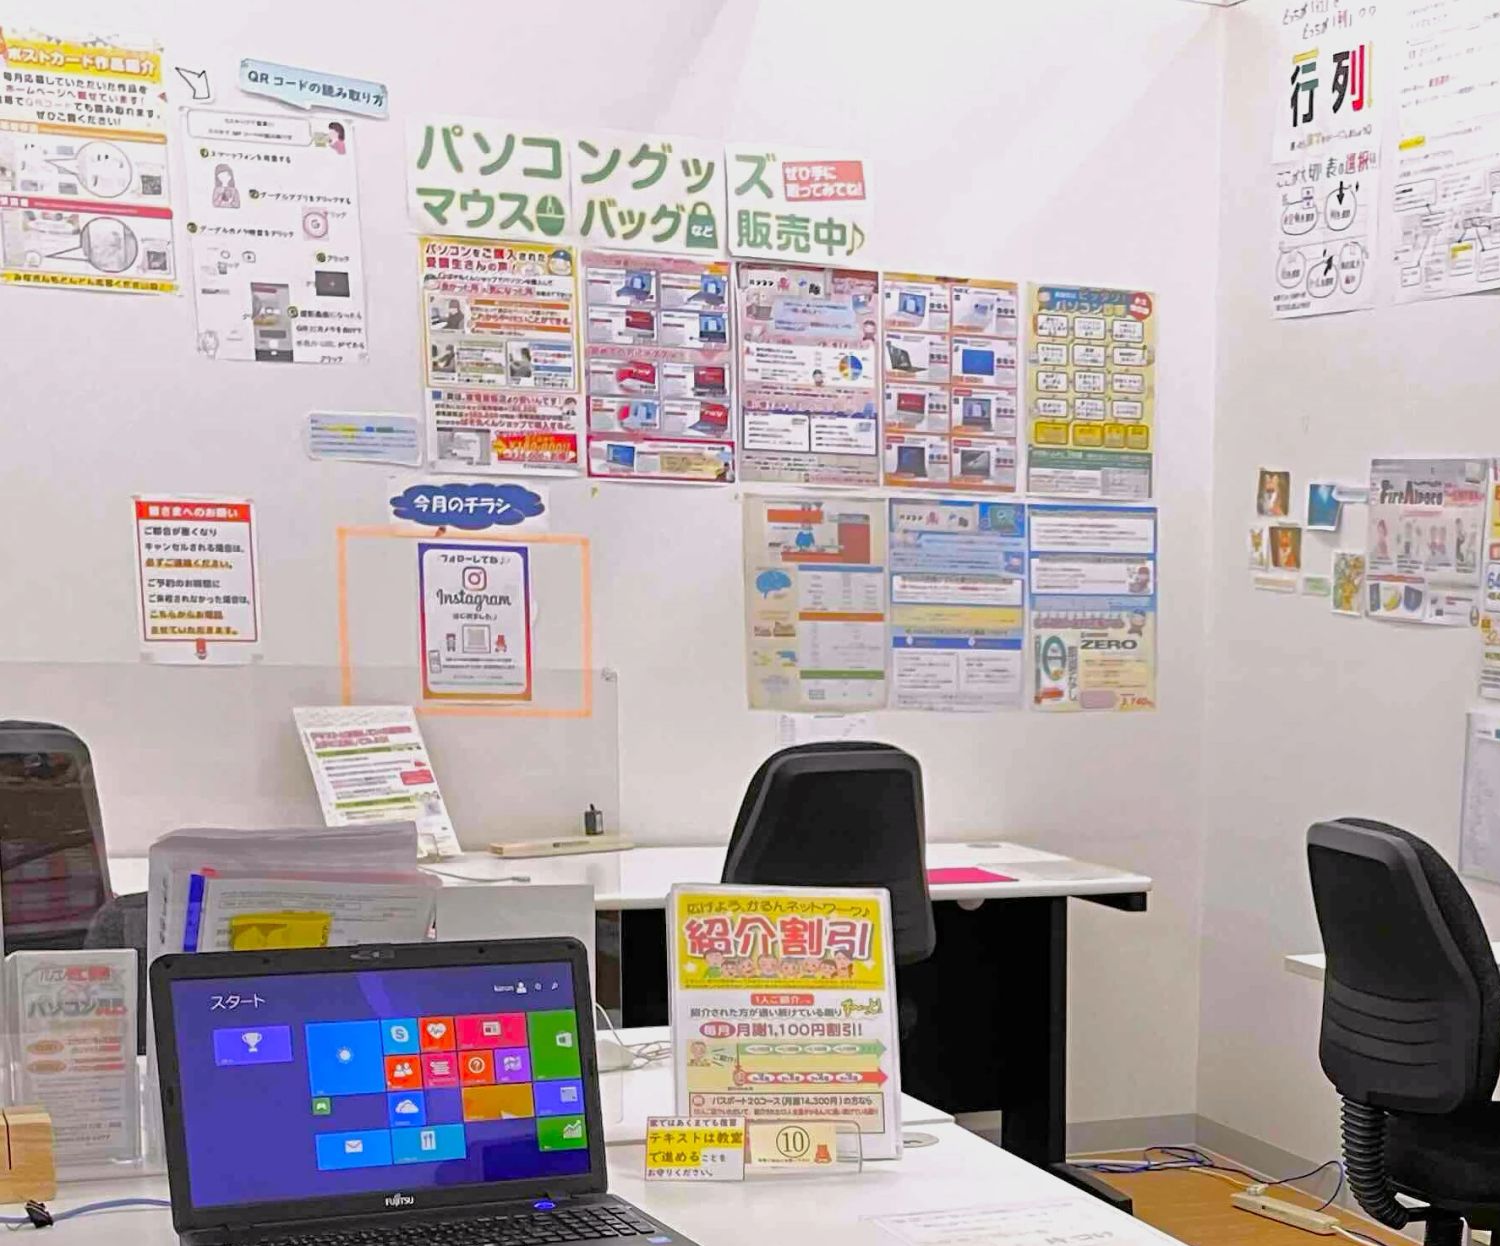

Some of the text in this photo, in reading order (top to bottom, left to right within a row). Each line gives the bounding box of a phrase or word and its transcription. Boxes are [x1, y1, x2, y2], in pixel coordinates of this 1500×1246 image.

[415, 188, 535, 233] マウス
[579, 199, 685, 242] バッグ
[690, 223, 713, 241] など
[413, 494, 512, 514] 今月のチラシ
[436, 589, 512, 612] Instagram
[1081, 639, 1138, 650] ZERO
[685, 916, 870, 958] 紹介割引
[209, 992, 266, 1012] スタート
[649, 1131, 743, 1146] テキストは教室
[385, 1195, 415, 1208] FUJITSU
